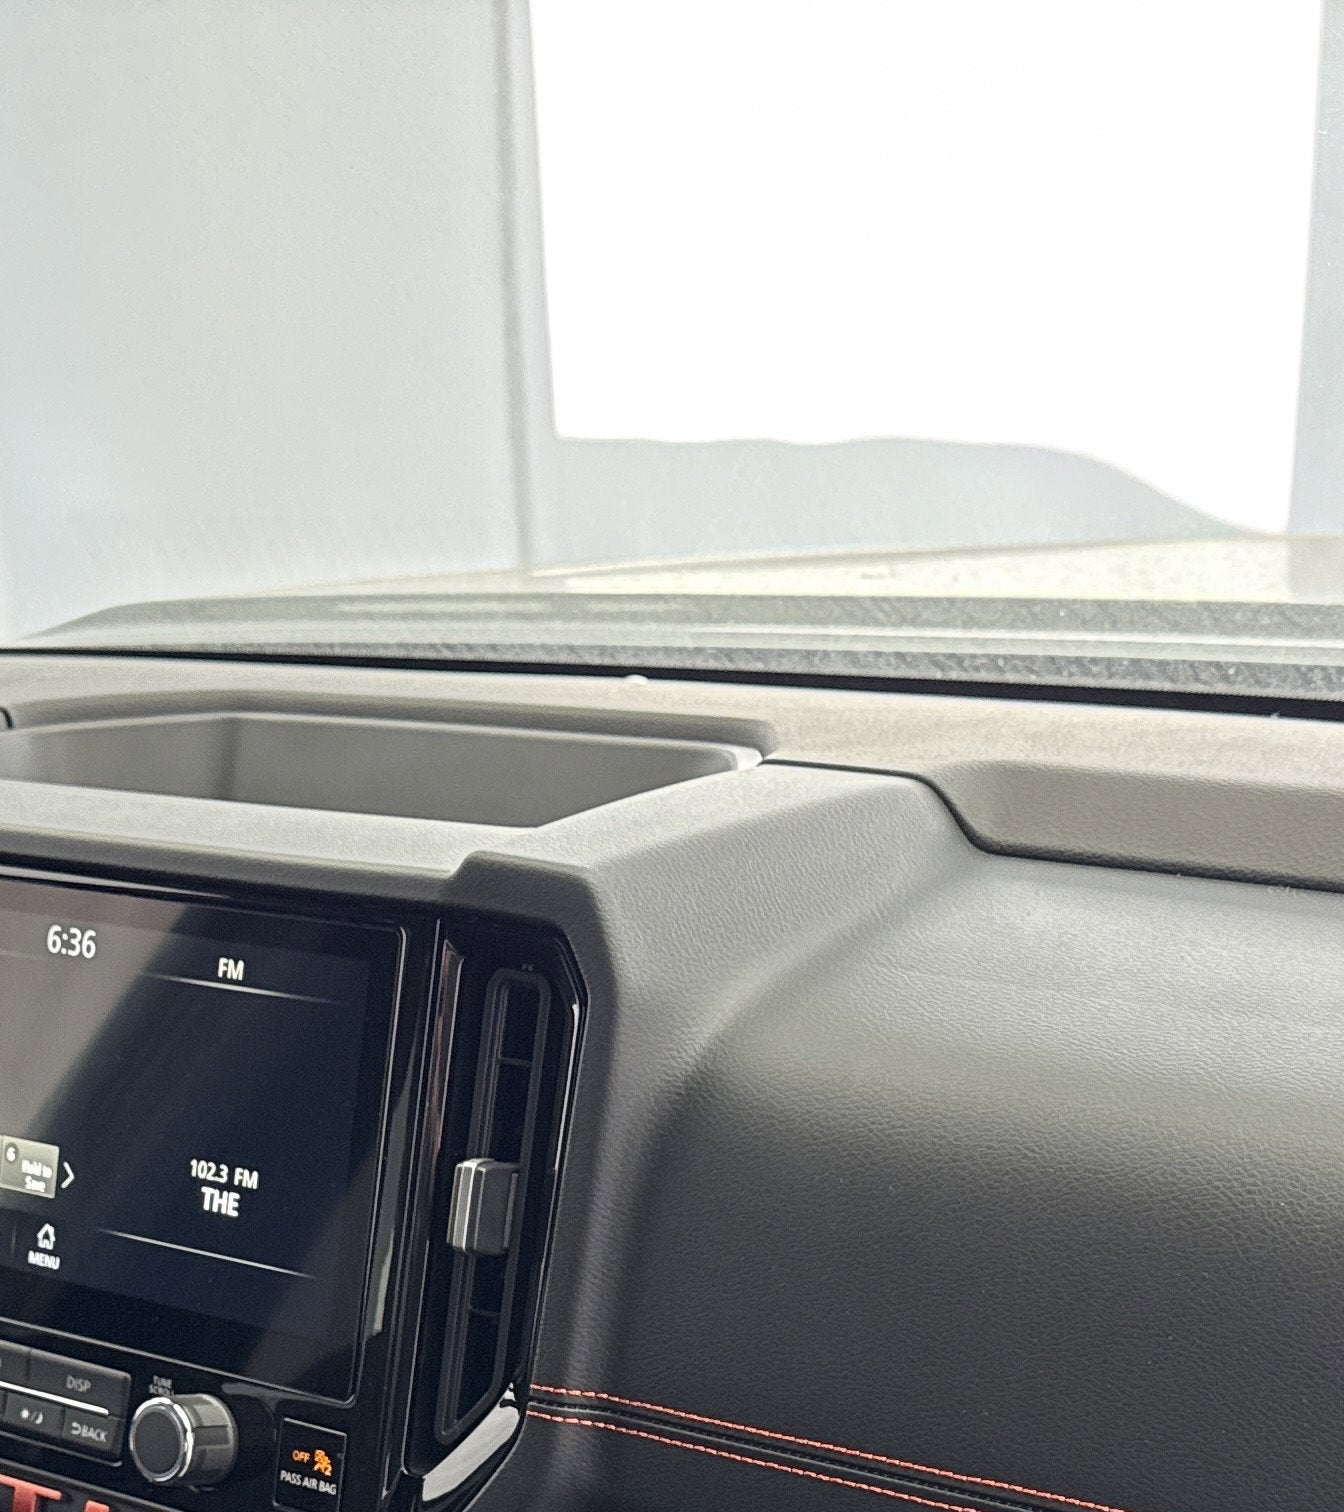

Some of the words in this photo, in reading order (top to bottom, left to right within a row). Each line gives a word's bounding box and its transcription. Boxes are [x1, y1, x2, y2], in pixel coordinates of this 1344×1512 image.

[46, 924, 97, 959] 6:36
[217, 957, 245, 981] FM
[6, 1146, 16, 1162] 6
[21, 1159, 42, 1177] Hold
[42, 1165, 53, 1178] to
[190, 1158, 229, 1184] 102.3
[233, 1167, 259, 1190] FM
[25, 1175, 46, 1193] Save
[200, 1186, 241, 1218] THE
[27, 1249, 61, 1271] MENU
[65, 1374, 92, 1393] DISP
[81, 1424, 107, 1443] BACK
[292, 1449, 311, 1464] OFF
[279, 1469, 302, 1486] PASS
[302, 1476, 318, 1490] AIR
[318, 1480, 337, 1496] BAG
